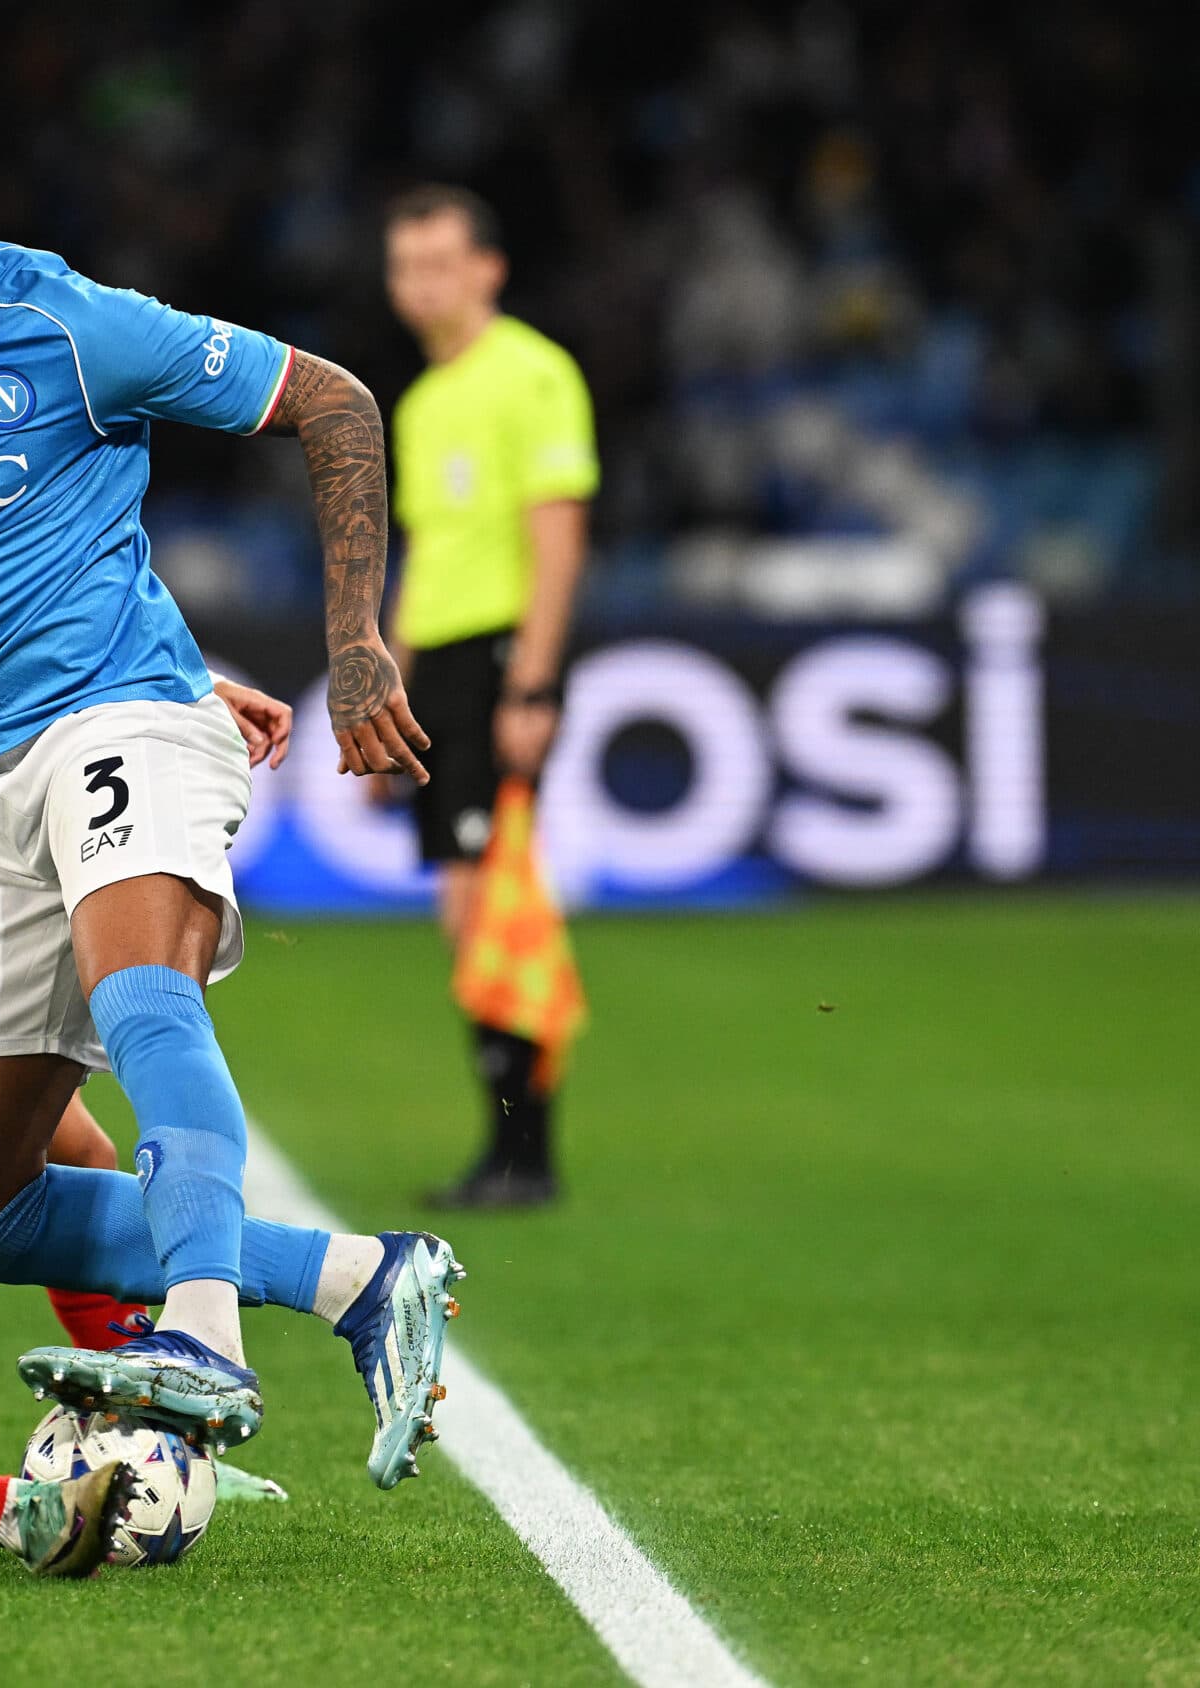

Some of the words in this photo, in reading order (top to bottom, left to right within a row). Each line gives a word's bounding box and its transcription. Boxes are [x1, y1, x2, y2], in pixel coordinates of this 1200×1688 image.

[205, 582, 1048, 912] psi
[84, 756, 129, 830] 3
[81, 825, 134, 863] EA7
